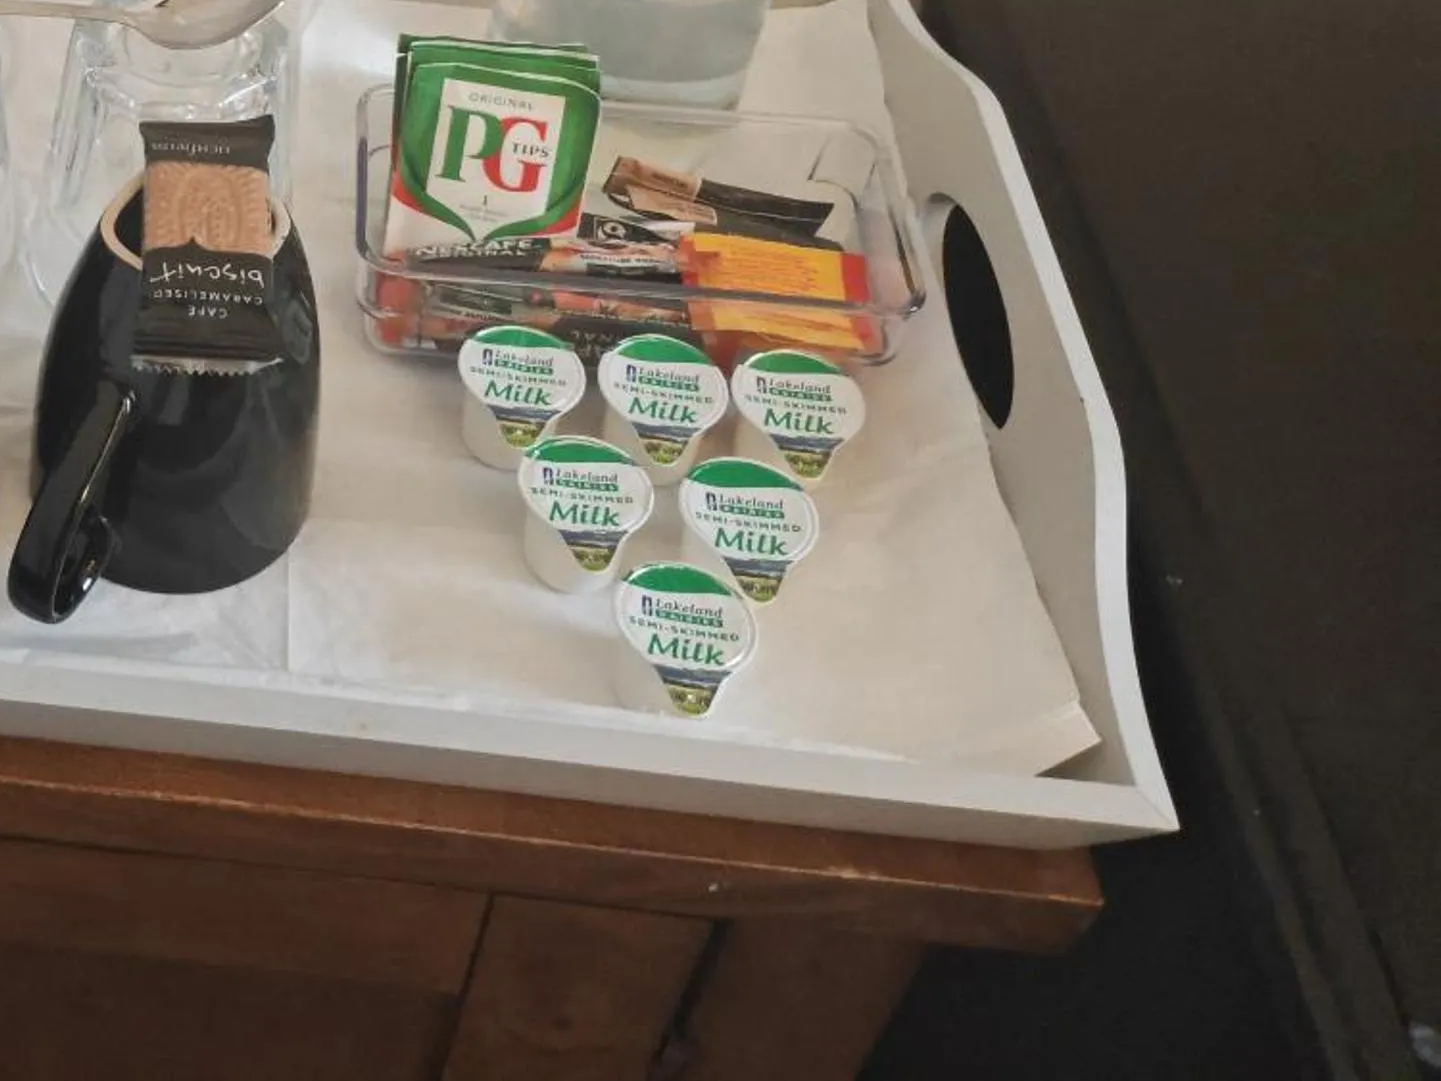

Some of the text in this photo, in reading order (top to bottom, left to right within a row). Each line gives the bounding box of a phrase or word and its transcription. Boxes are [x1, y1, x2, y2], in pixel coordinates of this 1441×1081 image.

[467, 91, 533, 112] ORIGINAL
[435, 104, 548, 193] PG
[512, 141, 551, 158] TIPS
[149, 261, 265, 289] biscuit
[153, 288, 263, 306] CARAMELISED
[484, 380, 552, 406] Milk
[628, 396, 697, 423] Milk
[764, 407, 835, 435] Milk
[555, 468, 618, 483] Lakeland
[549, 499, 620, 527] Milk
[720, 493, 784, 509] Lakeland
[715, 526, 789, 556] Milk
[656, 598, 723, 618] Lakeland
[647, 632, 725, 666] Milk
